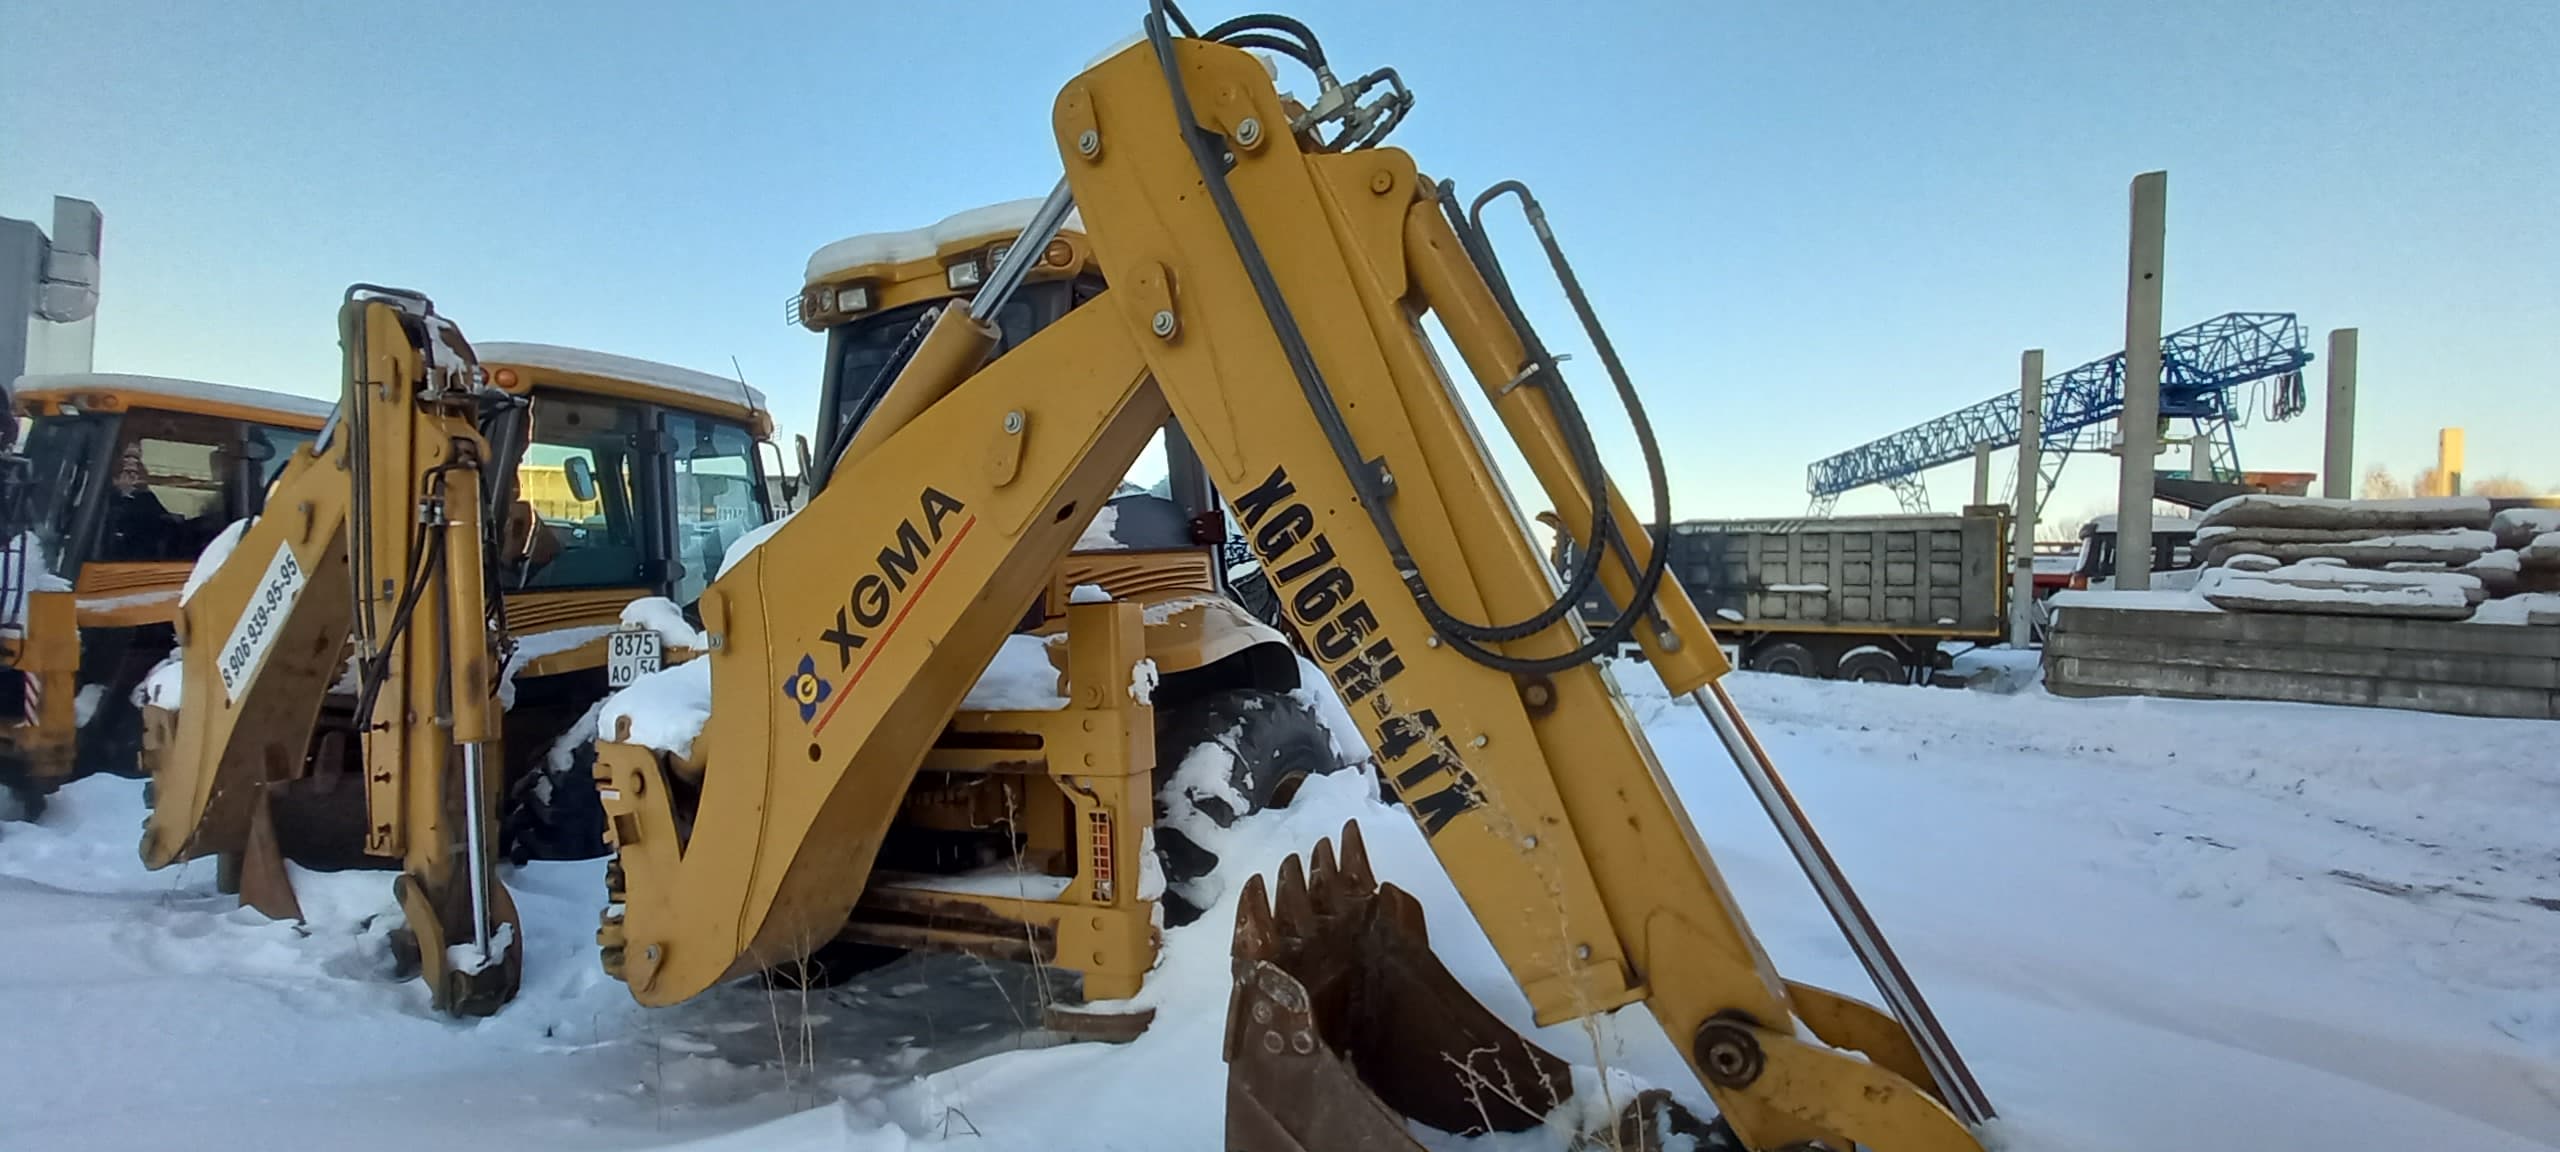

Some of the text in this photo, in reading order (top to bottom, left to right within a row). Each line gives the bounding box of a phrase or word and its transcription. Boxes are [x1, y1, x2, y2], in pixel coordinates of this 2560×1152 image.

[222, 554, 298, 689] 8 906 939-95-95
[614, 634, 654, 656] 8375
[819, 486, 965, 673] XGMA
